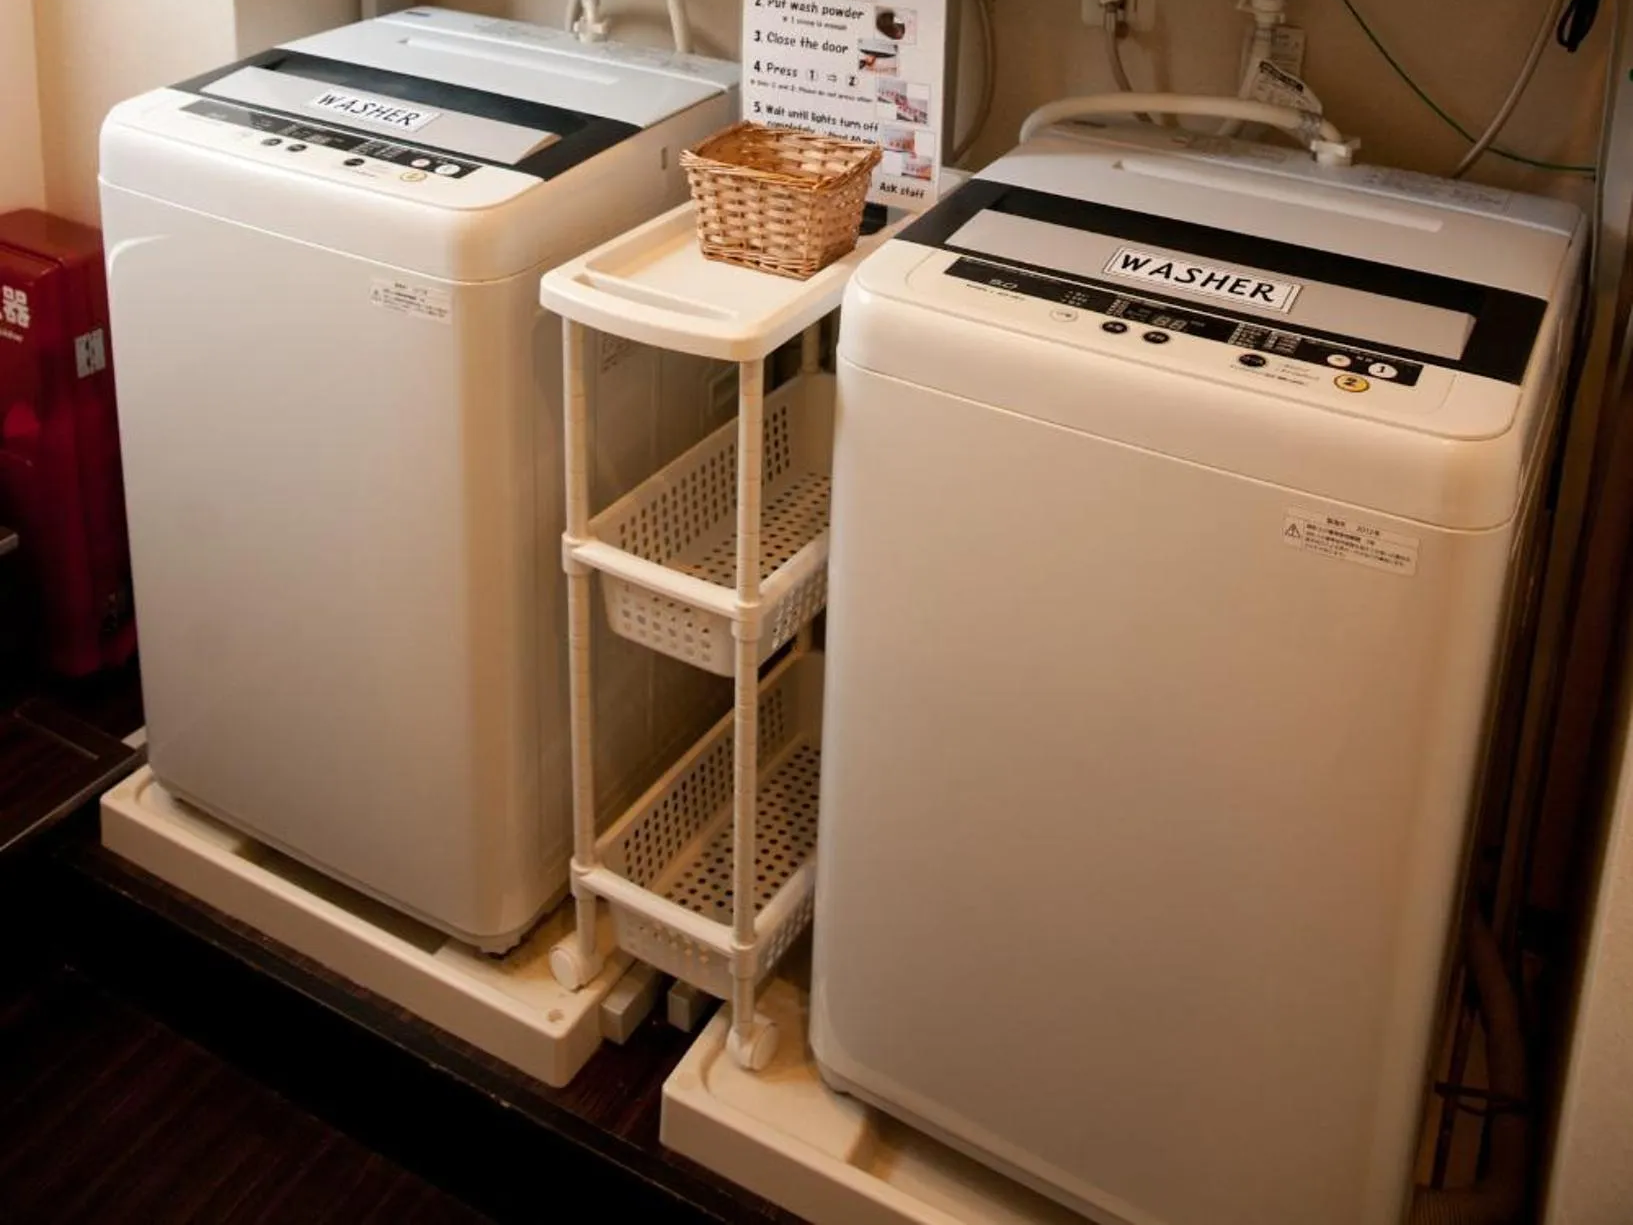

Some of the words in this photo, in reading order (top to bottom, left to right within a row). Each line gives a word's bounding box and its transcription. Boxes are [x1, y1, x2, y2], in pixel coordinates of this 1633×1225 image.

[790, 1, 819, 13] wash
[822, 5, 864, 19] powder
[767, 31, 796, 46] Close
[800, 36, 819, 50] the
[822, 40, 849, 54] door
[767, 62, 798, 77] Press
[316, 92, 421, 127] WASHER
[766, 104, 785, 116] Wait
[880, 182, 898, 194] Ask
[900, 186, 925, 199] staff
[1120, 253, 1277, 304] WASHER
[0, 285, 30, 328] 器
[1343, 378, 1357, 388] 2
